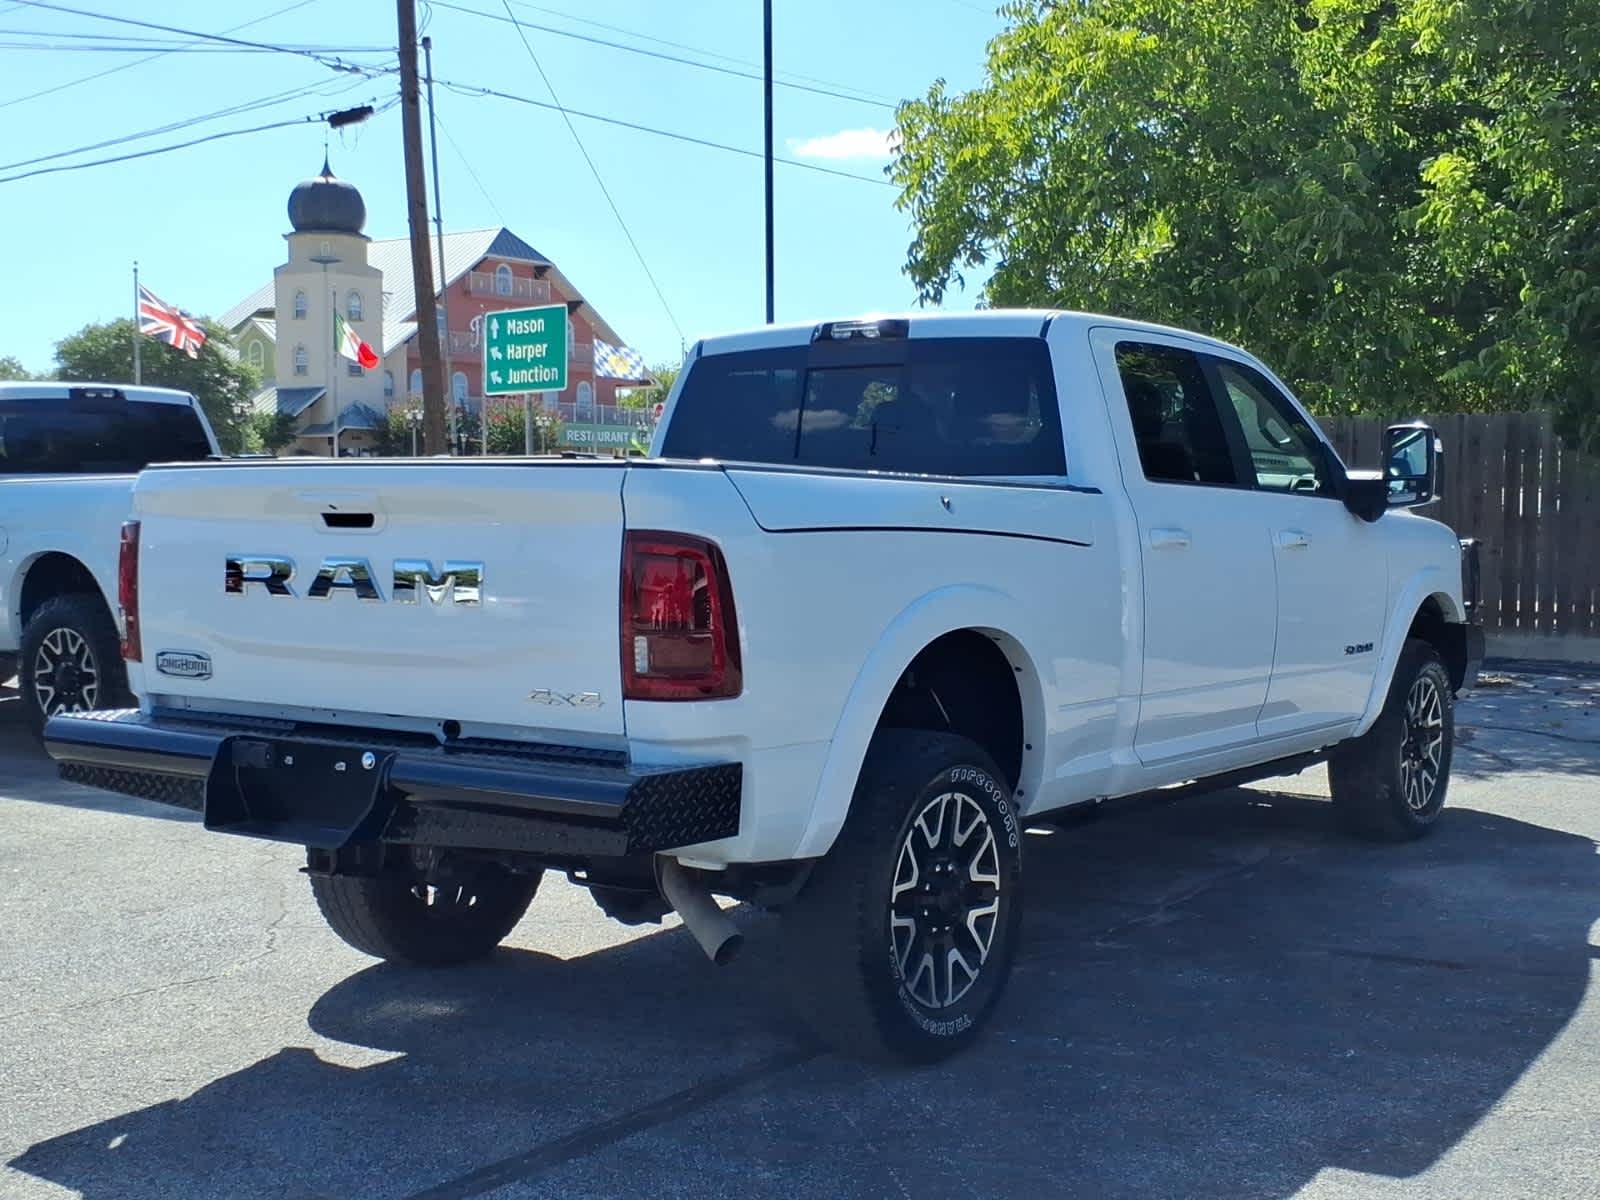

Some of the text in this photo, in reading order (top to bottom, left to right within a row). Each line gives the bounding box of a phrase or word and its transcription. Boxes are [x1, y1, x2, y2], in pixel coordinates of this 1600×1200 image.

[507, 318, 545, 336] Mason
[506, 343, 548, 363] Harper
[507, 365, 559, 385] Junction
[225, 553, 485, 607] RAM
